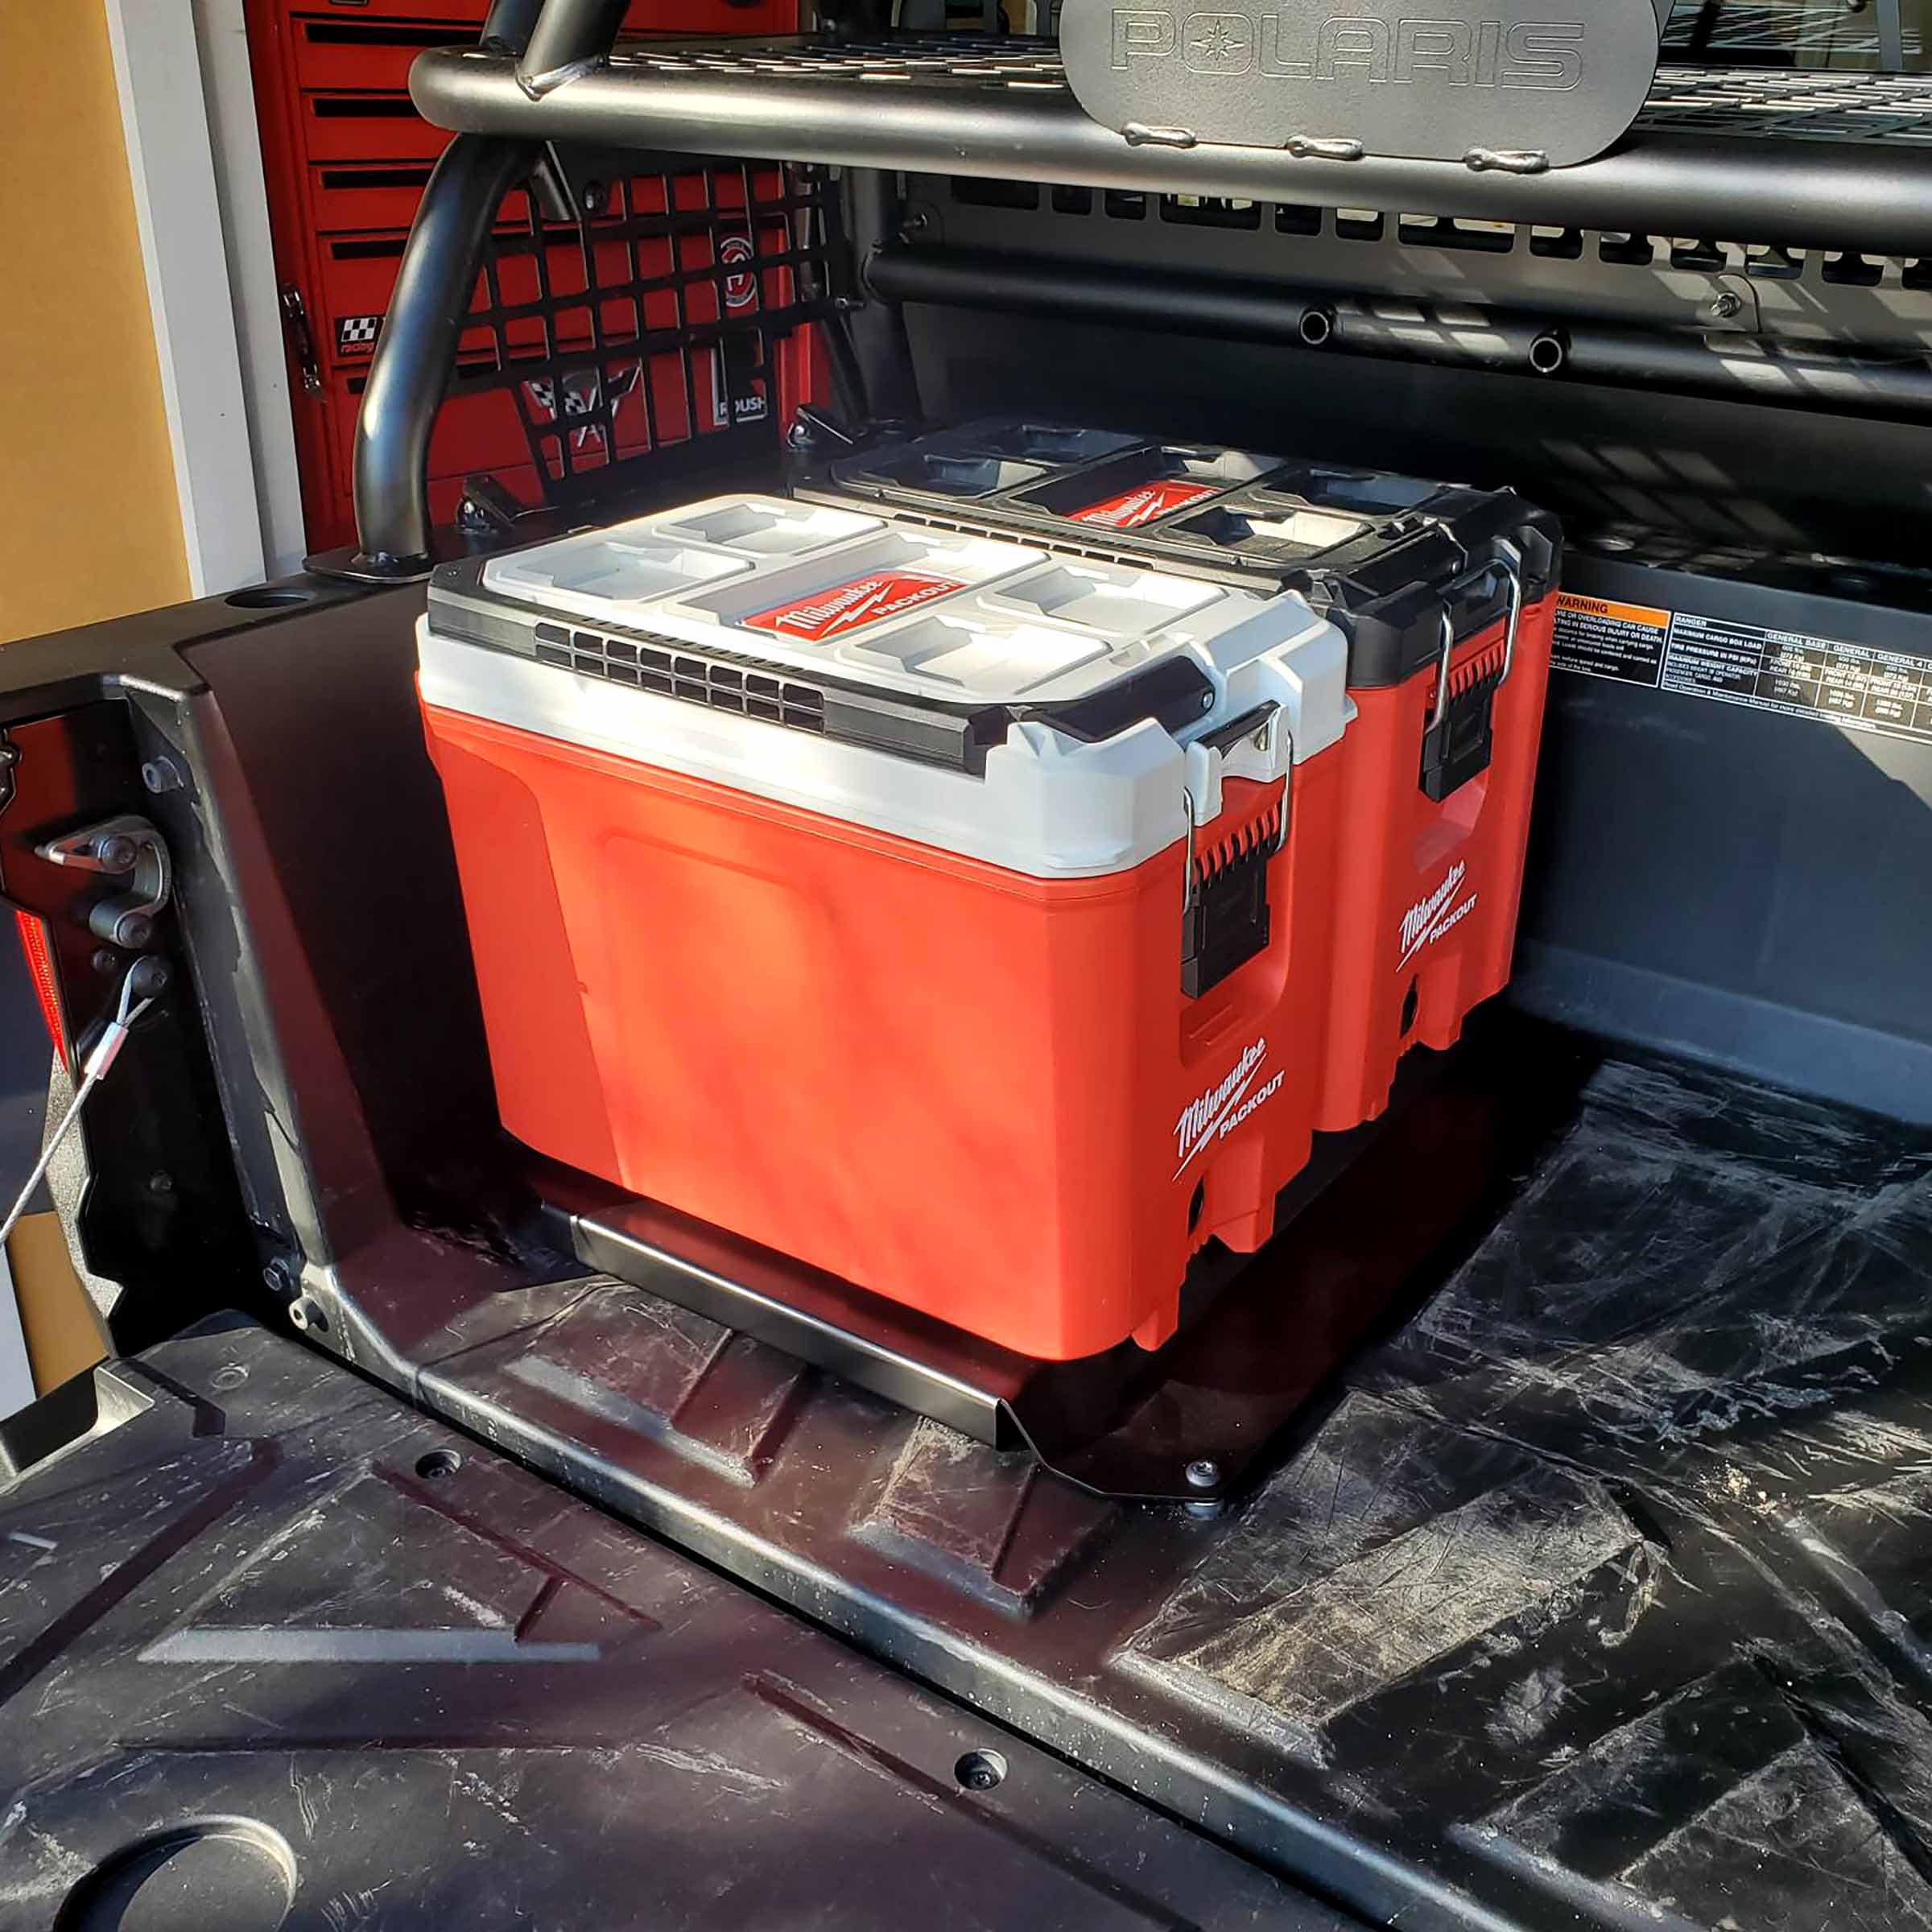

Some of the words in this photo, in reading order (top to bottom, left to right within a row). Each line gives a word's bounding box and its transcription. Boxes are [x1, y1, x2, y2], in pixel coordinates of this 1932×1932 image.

[1111, 8, 1585, 93] POLARIS
[774, 580, 886, 630] Milwaukee
[873, 581, 958, 616] PACKOUT
[1577, 613, 1622, 628] OVERLOADING
[1622, 621, 1637, 630] CAN
[1637, 624, 1659, 634] CAUSE
[1675, 615, 1707, 627] RANGER
[1586, 631, 1604, 641] braking
[1607, 627, 1629, 638] INJURY
[1630, 631, 1640, 639] OR
[1674, 627, 1705, 639] MAXIMUM
[1705, 633, 1728, 644] CARGO
[1728, 638, 1744, 646] BOX
[1744, 640, 1763, 650] LOAD
[1767, 632, 1803, 645] GENERAL
[1806, 639, 1827, 649] BASE
[1671, 642, 1685, 651] TIRE
[1686, 645, 1719, 658] PRESSURE
[1719, 651, 1728, 659] IN
[1834, 645, 1870, 658] GENERAL
[1877, 653, 1914, 667] GENERAL
[1700, 659, 1725, 671] WEIGHT
[1726, 665, 1758, 677] CAPACITY
[1398, 859, 1466, 953] Milwaukee
[1429, 894, 1478, 943] PACKOUT
[1172, 1037, 1266, 1157] Milwaukee
[1218, 1069, 1285, 1140] PACKOUT
